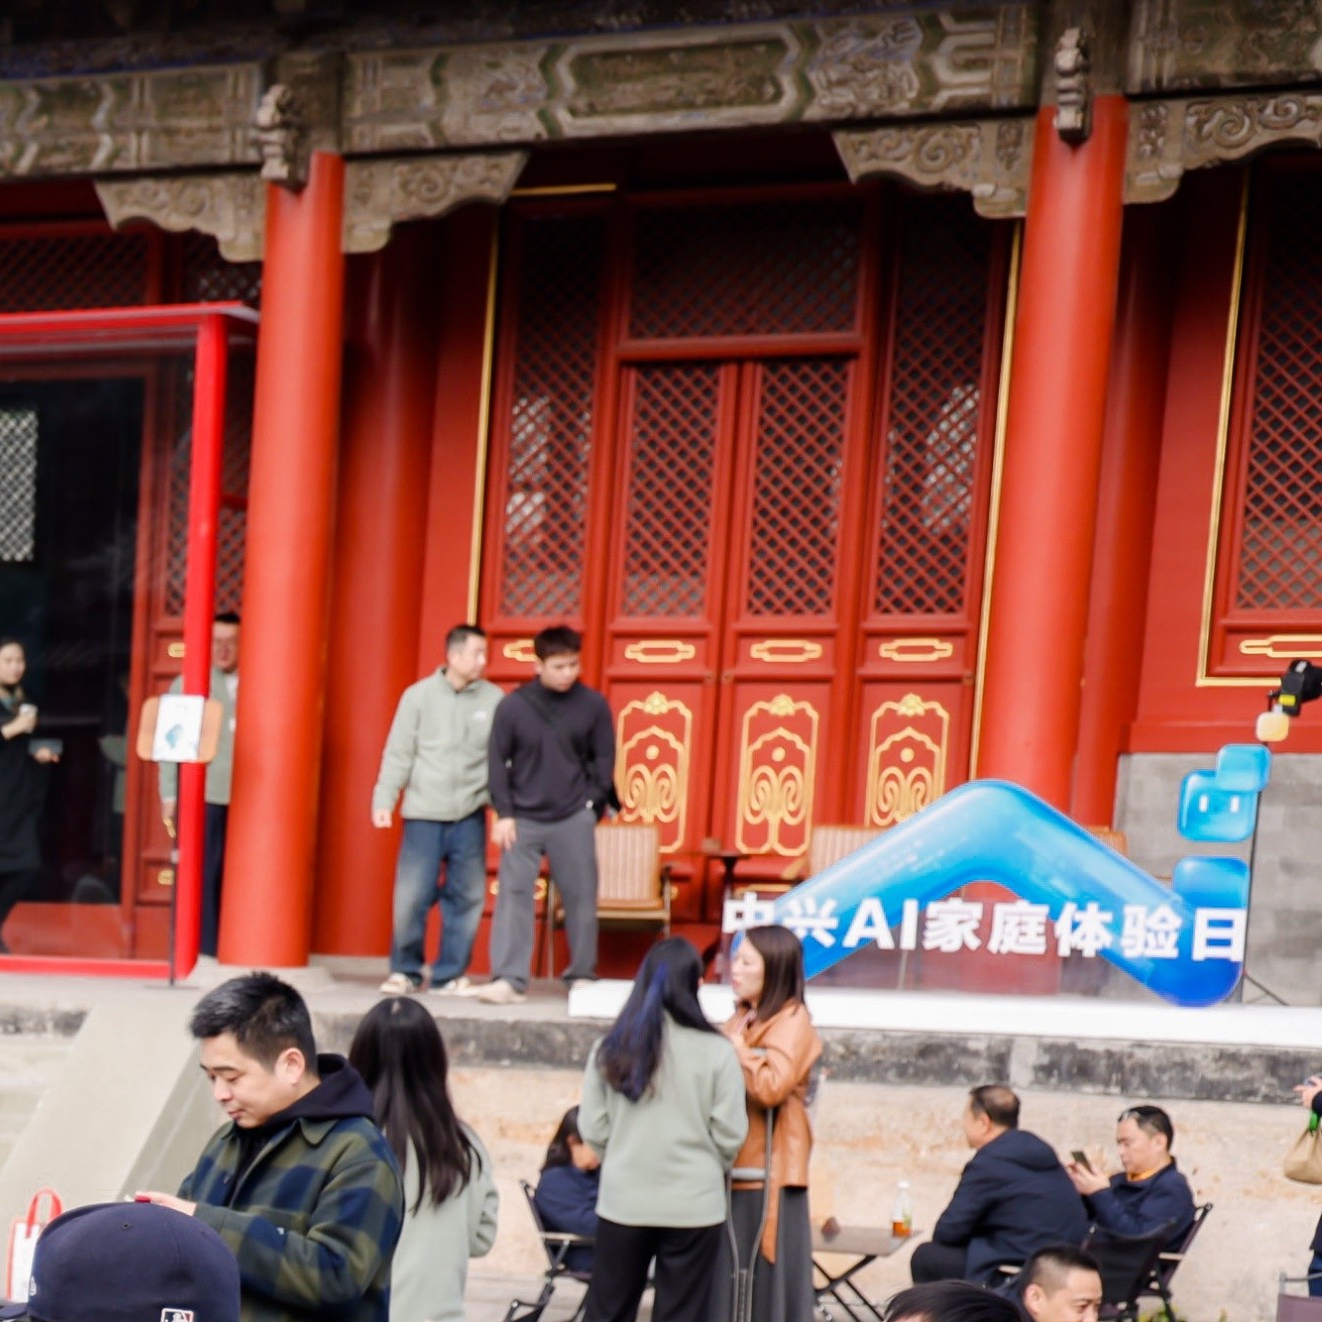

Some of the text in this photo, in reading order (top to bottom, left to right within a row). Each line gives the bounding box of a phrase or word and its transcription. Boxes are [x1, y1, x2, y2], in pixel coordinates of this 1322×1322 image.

[722, 894, 1245, 962] 中兴AI家庭体验日
